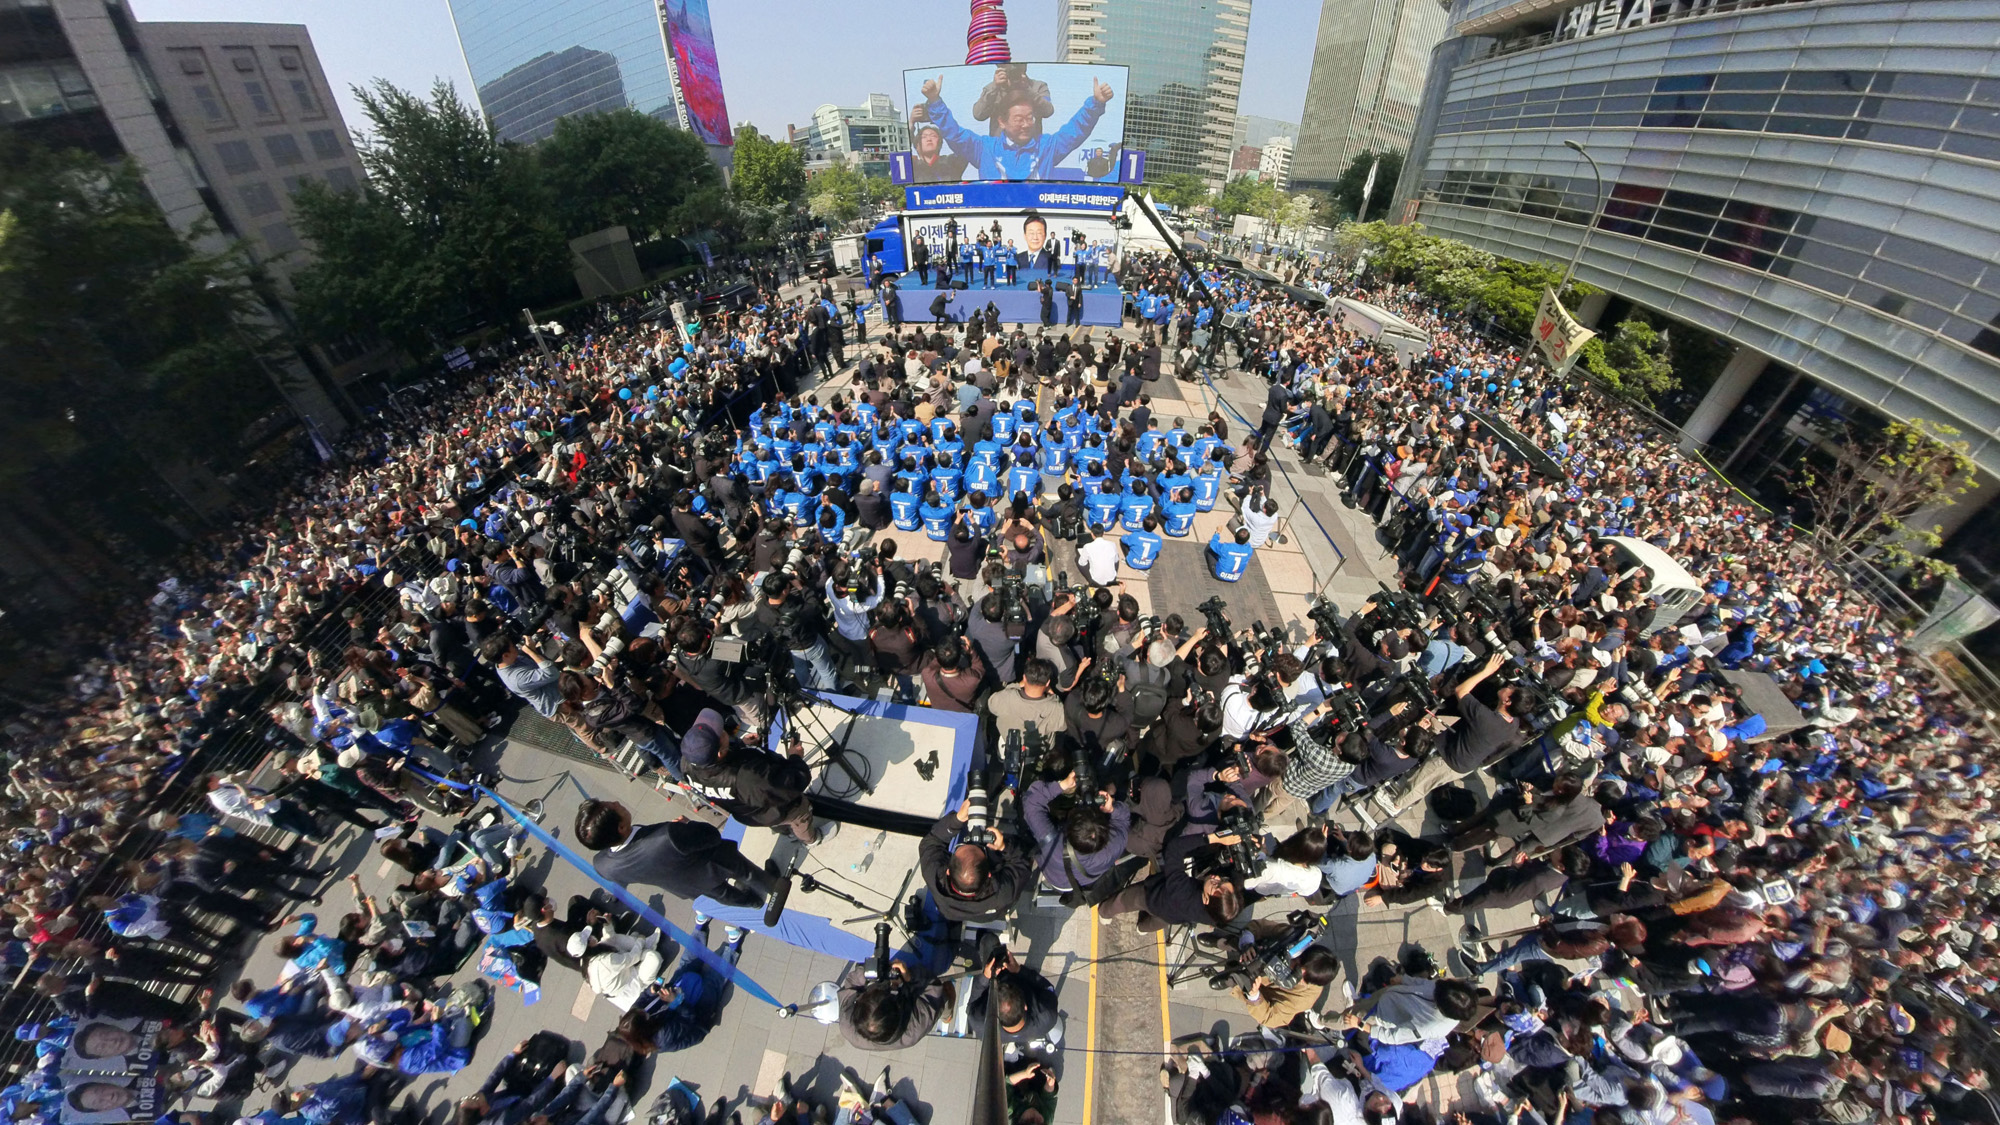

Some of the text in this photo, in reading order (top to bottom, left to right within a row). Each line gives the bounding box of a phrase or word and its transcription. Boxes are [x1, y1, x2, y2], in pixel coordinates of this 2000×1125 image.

[669, 57, 680, 86] MEDIA
[675, 86, 684, 103] ART
[896, 155, 906, 180] 1
[1128, 153, 1138, 180] 1
[913, 191, 920, 206] 1
[936, 193, 964, 205] 이재명
[1039, 193, 1118, 206] 이제부터 진짜 대한민국
[1063, 237, 1070, 256] 1
[999, 420, 1006, 433] 1
[1053, 450, 1061, 464] 1
[977, 465, 984, 481] 1
[1020, 474, 1027, 491] 1
[1205, 482, 1212, 499] 1
[898, 504, 905, 519] 1
[1104, 508, 1110, 521] 1
[1135, 508, 1143, 521] 1
[1181, 517, 1188, 530] 1
[1141, 542, 1151, 560] 1
[1232, 556, 1242, 573] 1
[131, 1078, 156, 1120] 1 이재명
